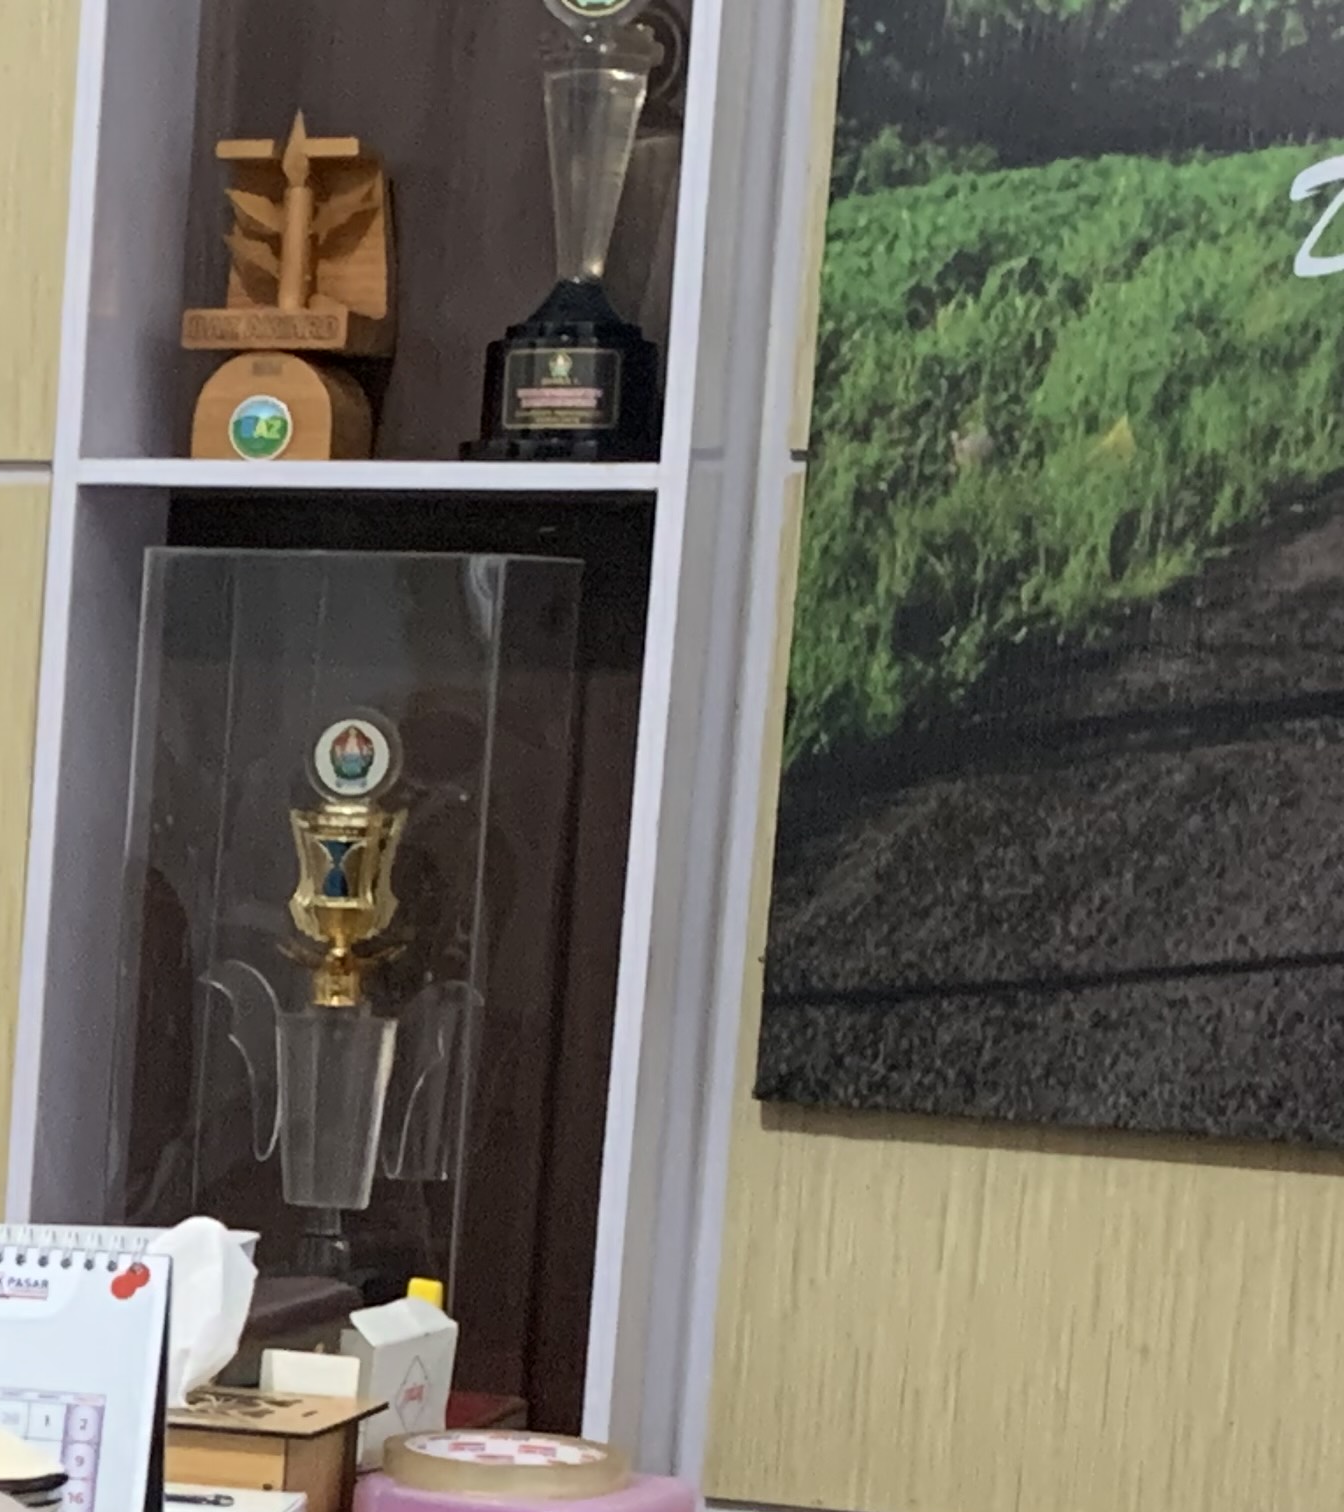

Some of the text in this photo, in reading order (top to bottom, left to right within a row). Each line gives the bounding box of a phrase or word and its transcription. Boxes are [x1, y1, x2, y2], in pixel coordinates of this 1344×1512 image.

[7, 1276, 49, 1289] PASAR
[44, 1414, 51, 1428] 1
[79, 1418, 88, 1431] 2
[74, 1455, 85, 1468] 9
[68, 1493, 85, 1506] 16
